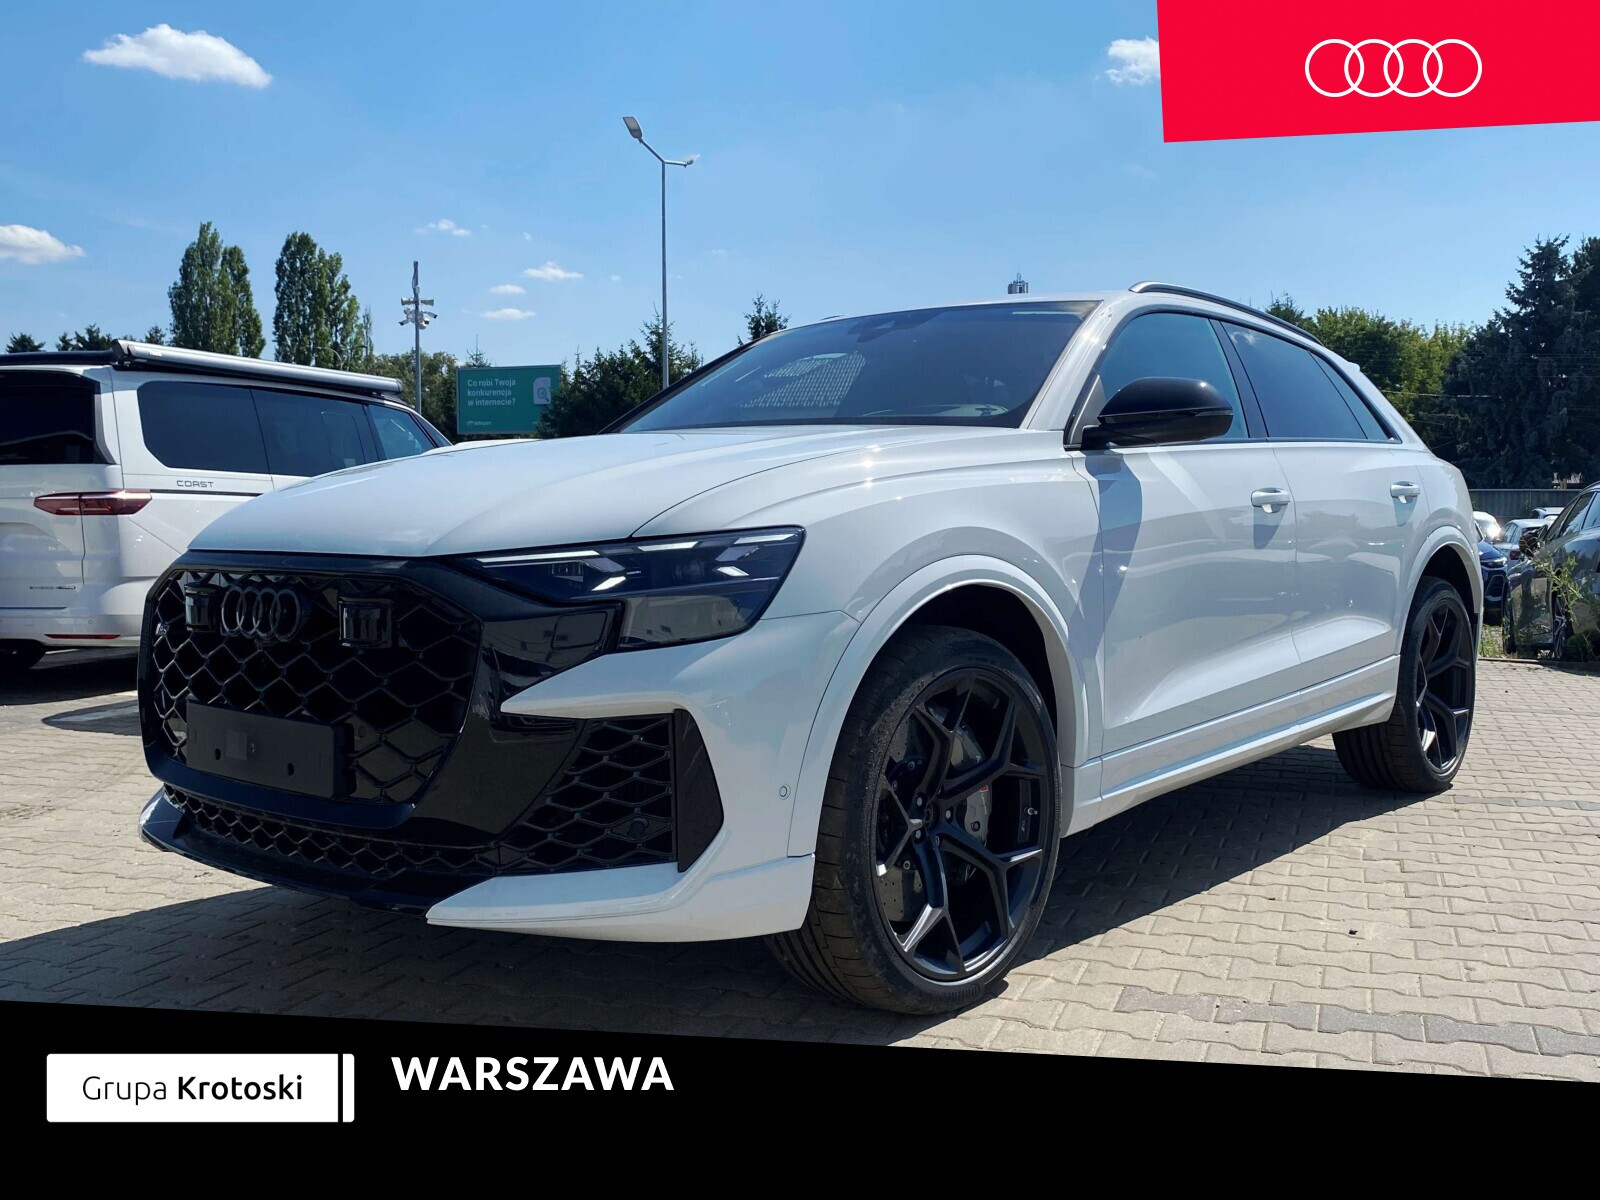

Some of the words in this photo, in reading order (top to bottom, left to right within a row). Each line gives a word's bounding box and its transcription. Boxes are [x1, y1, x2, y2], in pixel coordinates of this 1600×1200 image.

[467, 379, 478, 387] Co
[478, 378, 493, 387] robi
[495, 377, 516, 388] Twoja
[467, 389, 512, 398] konkurencja
[475, 397, 516, 406] internecie?
[176, 480, 214, 488] COAST
